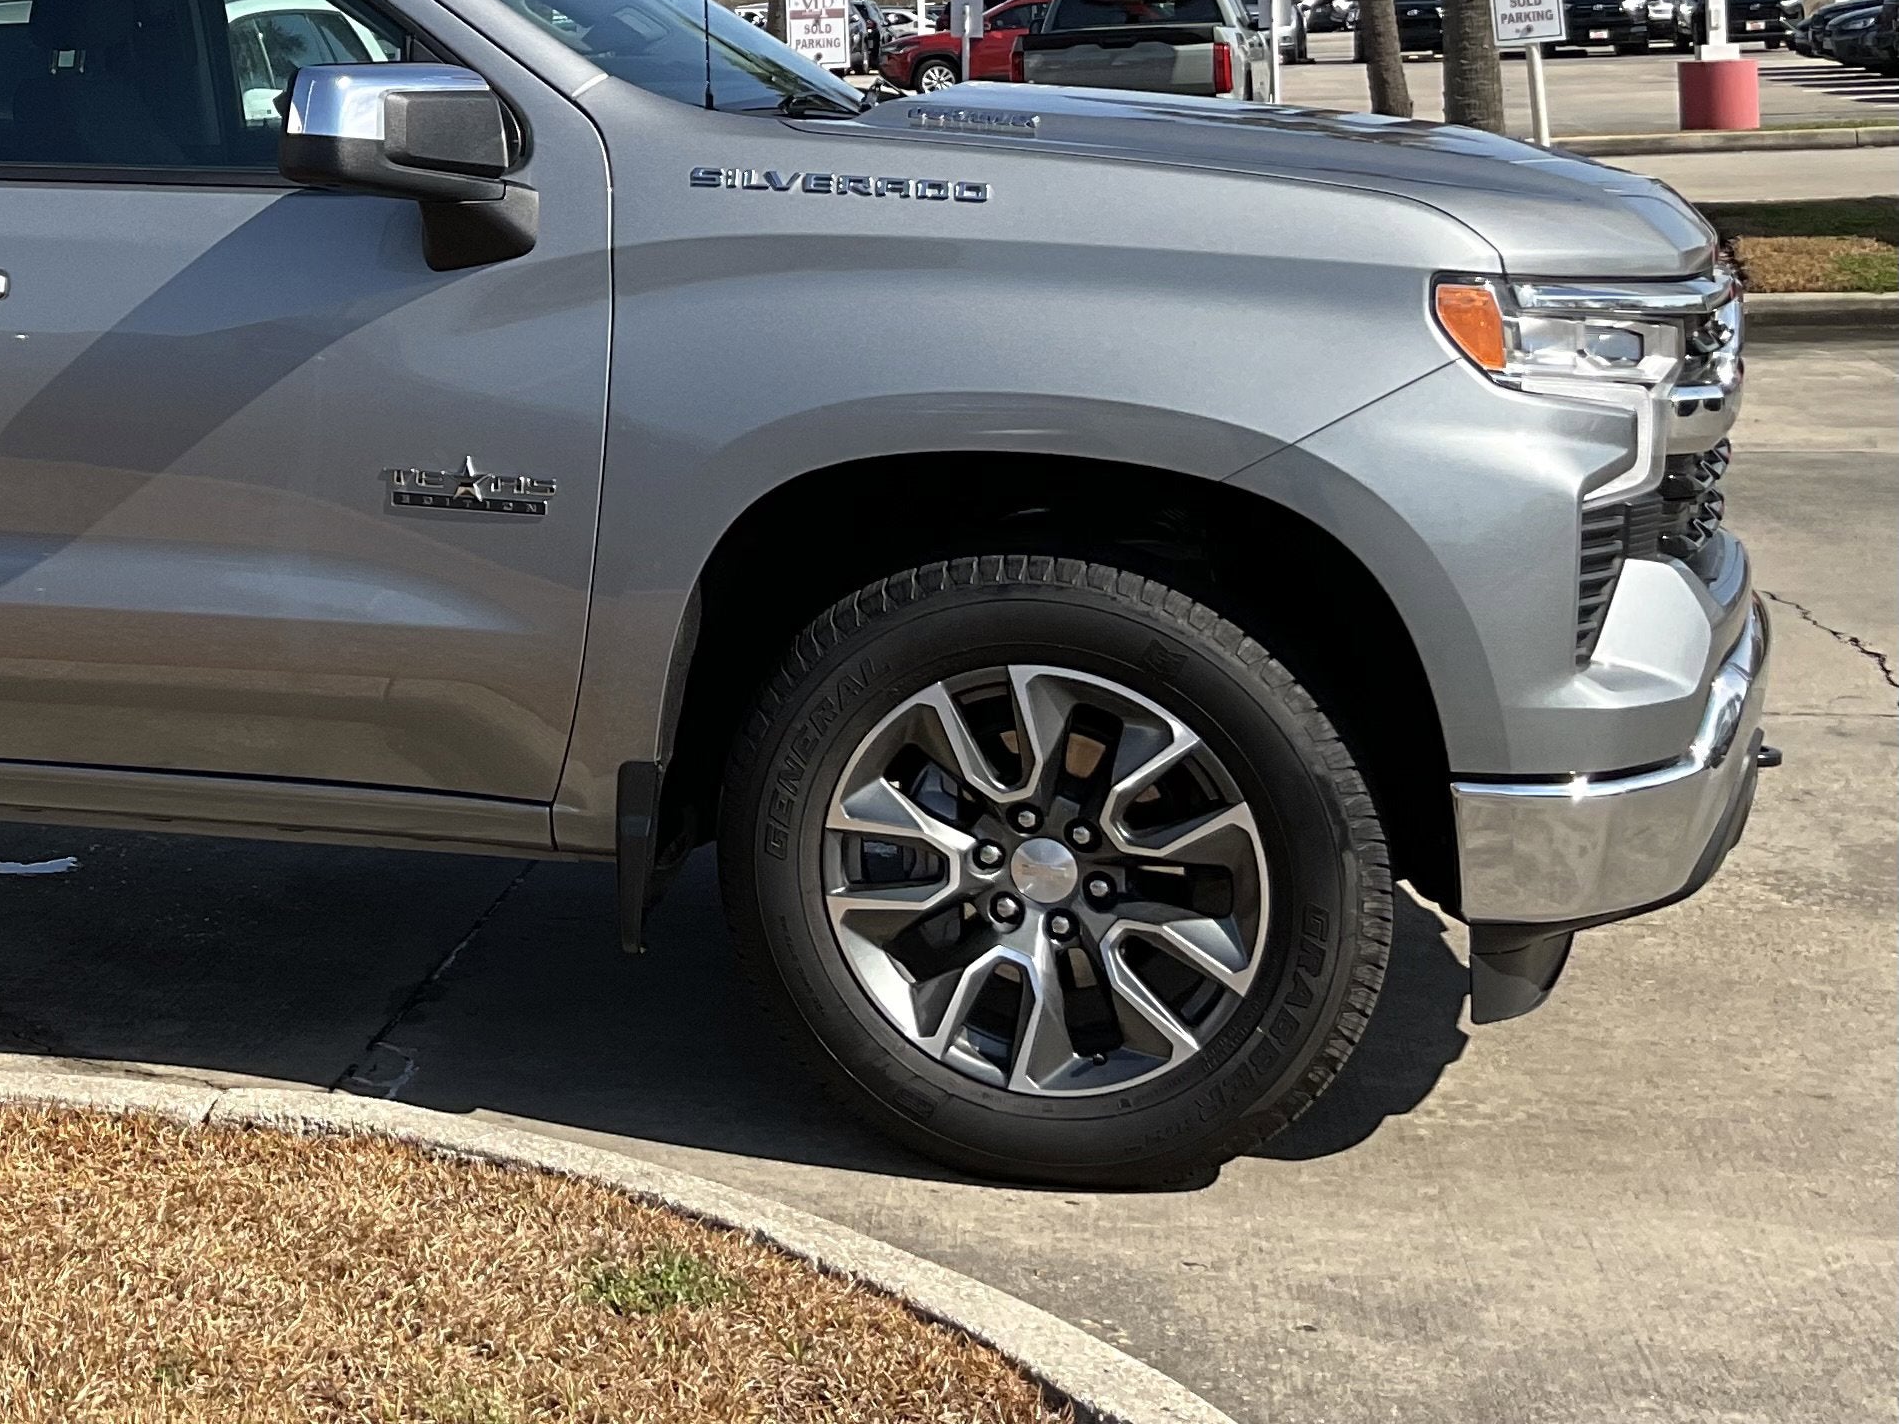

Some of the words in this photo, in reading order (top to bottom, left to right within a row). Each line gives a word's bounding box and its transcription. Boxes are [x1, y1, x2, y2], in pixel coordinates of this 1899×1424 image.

[1500, 9, 1554, 24] PARKING
[804, 23, 832, 34] SOLD
[795, 37, 841, 50] PARKING
[690, 166, 991, 203] SILVERADO
[400, 495, 538, 513] EDITION
[764, 655, 893, 861] GENERAL
[1193, 902, 1331, 1123] GRABBER
